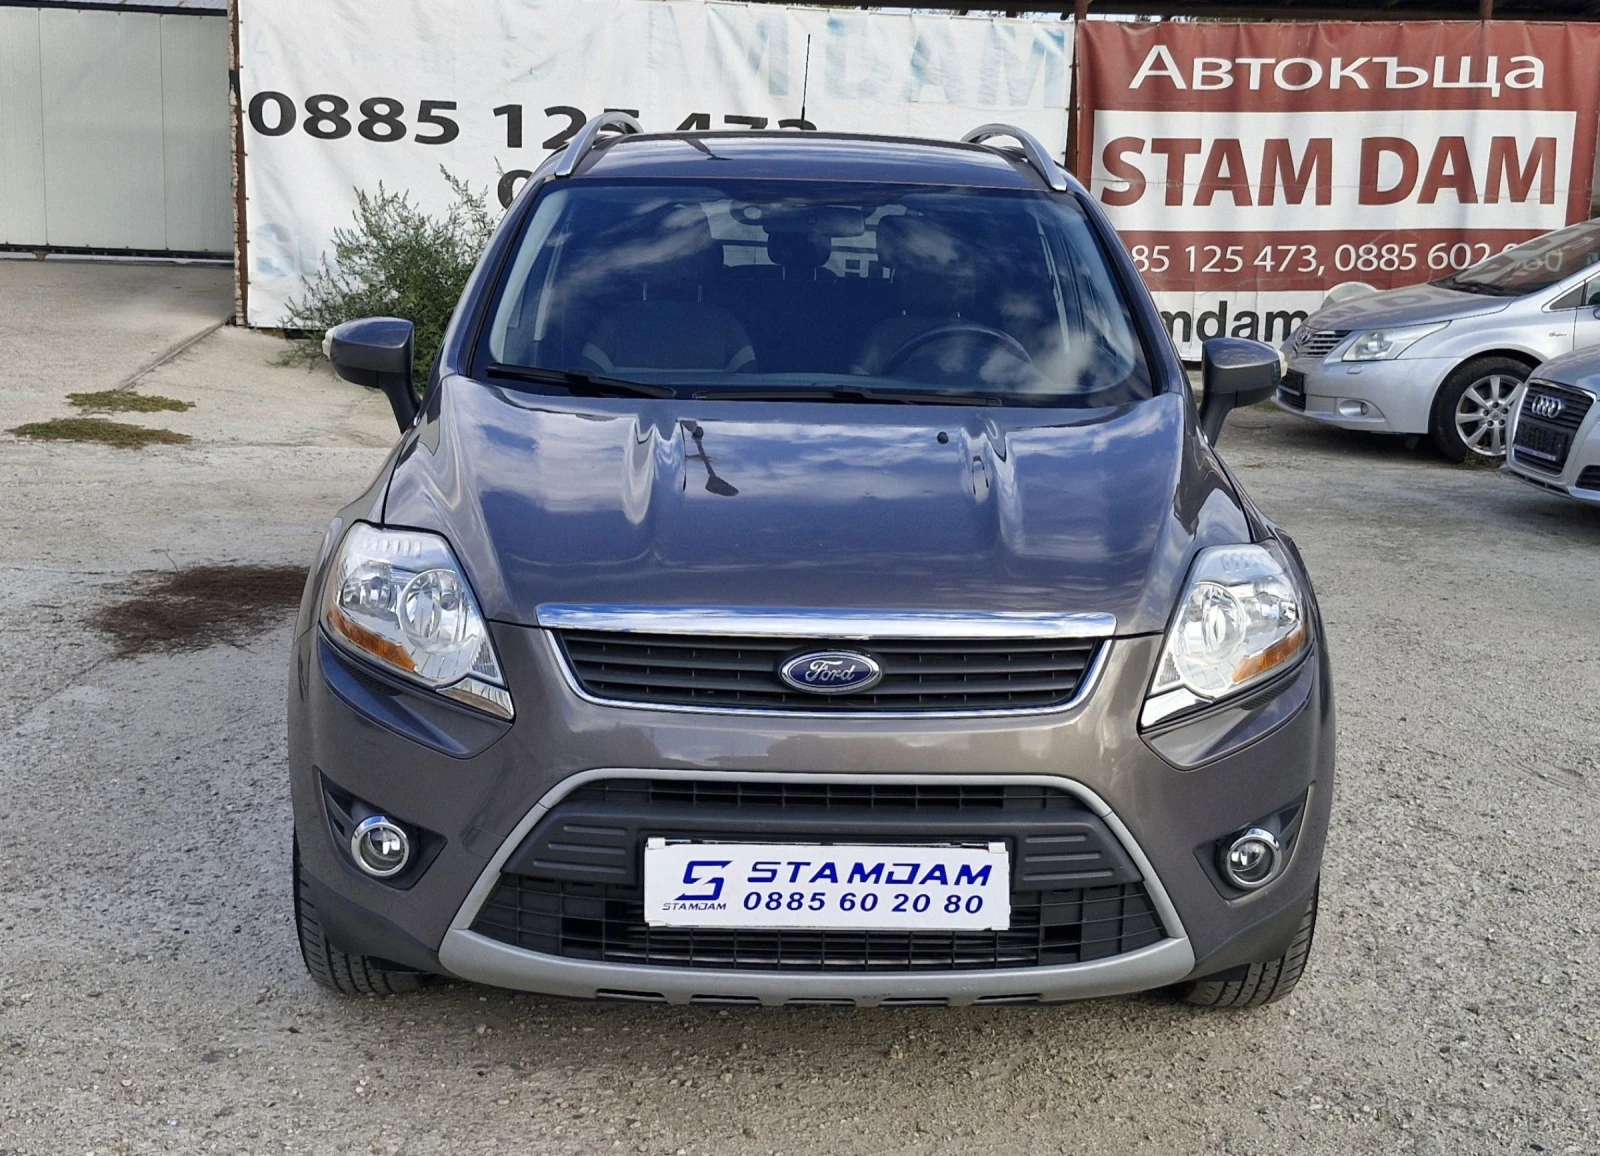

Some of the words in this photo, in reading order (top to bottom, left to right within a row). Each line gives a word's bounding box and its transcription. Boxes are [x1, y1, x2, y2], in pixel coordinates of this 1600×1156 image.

[1128, 45, 1545, 98] Автокъща
[248, 91, 459, 145] 0885
[1101, 136, 1333, 207] STAM
[1357, 136, 1558, 206] DAM
[1131, 245, 1170, 273] 85
[1185, 245, 1244, 273] 125
[1253, 245, 1325, 277] 473,
[1334, 243, 1417, 271] 0885
[1160, 301, 1309, 343] mdam
[805, 660, 856, 681] Ford
[743, 891, 826, 911] 0885
[839, 892, 879, 912] 60
[891, 893, 931, 913] 20
[943, 895, 984, 914] 80
